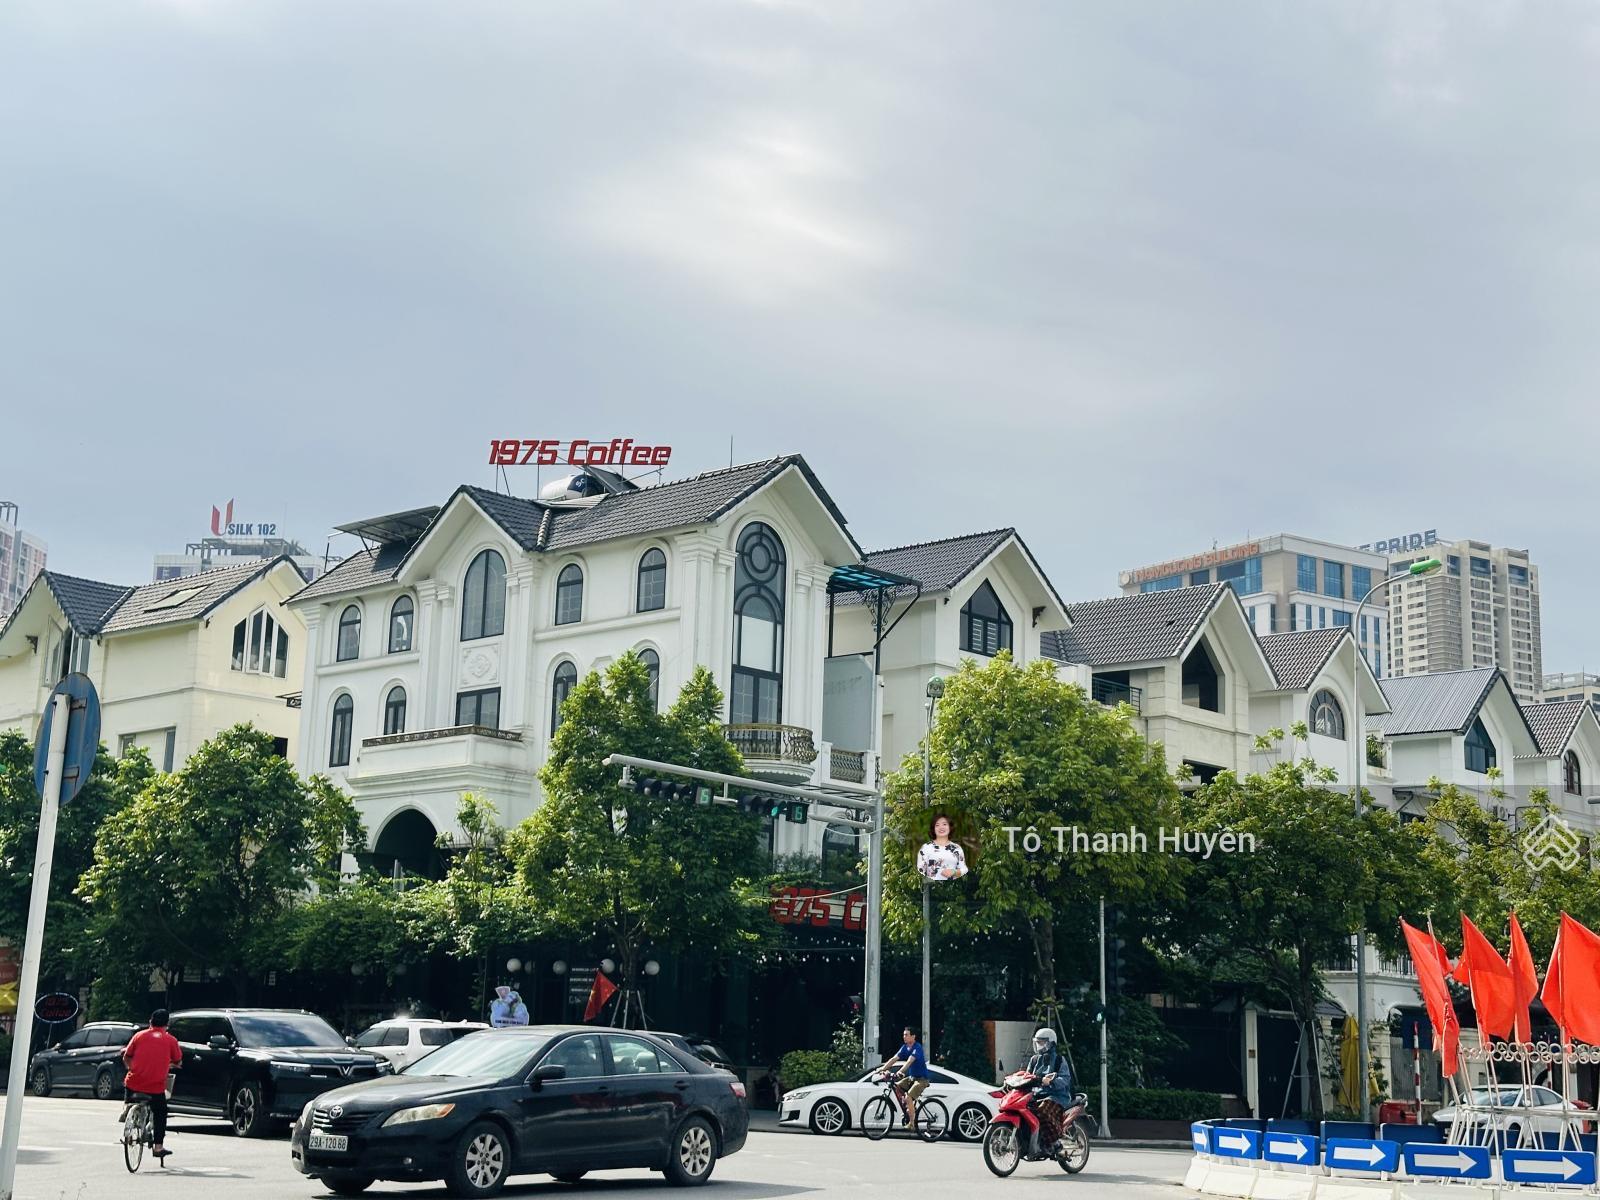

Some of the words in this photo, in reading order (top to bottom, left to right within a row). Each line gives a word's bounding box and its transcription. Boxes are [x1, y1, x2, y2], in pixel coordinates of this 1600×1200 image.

[489, 440, 560, 465] 1975
[568, 438, 672, 466] Coffee
[258, 523, 277, 536] 102
[1376, 529, 1437, 555] PRIDE
